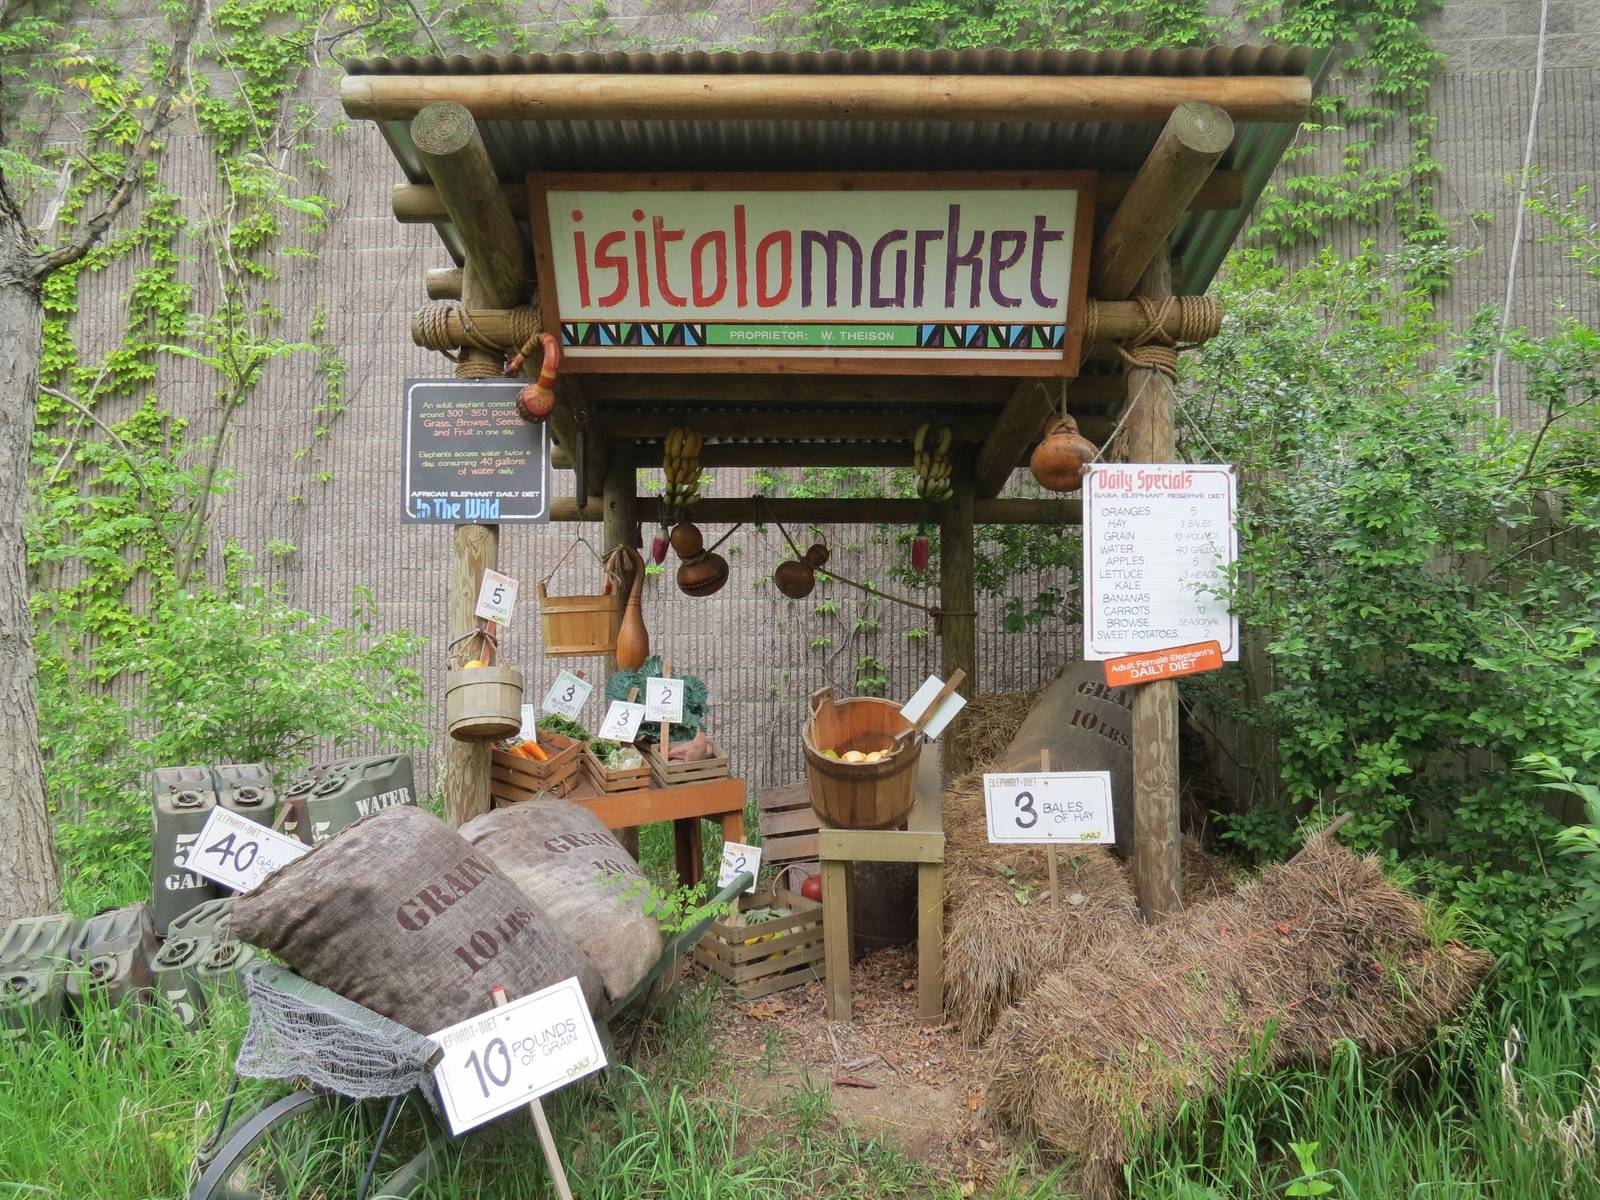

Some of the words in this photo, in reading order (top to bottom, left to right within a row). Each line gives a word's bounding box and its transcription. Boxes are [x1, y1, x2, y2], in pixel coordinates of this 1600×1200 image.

[729, 330, 808, 341] PROPRIETOR:
[821, 330, 836, 341] W.
[841, 331, 895, 341] THEISON
[422, 401, 433, 409] An
[436, 401, 453, 409] adult
[455, 401, 485, 410] elephant
[447, 409, 464, 418] 300
[471, 408, 488, 417] 350
[423, 418, 452, 429] Grass,
[456, 417, 492, 427] Browse,
[495, 416, 526, 427] Seeds,
[432, 428, 450, 437] and
[453, 427, 474, 436] Fruit
[418, 451, 452, 459] Elephants
[504, 449, 524, 457] twice
[438, 459, 477, 468] consuming
[480, 457, 493, 466] 40
[495, 457, 526, 468] gallons
[457, 467, 466, 476] of
[471, 467, 496, 476] water
[1099, 469, 1133, 492] Daily
[1137, 469, 1194, 492] Specials
[1121, 492, 1164, 500] ELEPHANT
[1167, 492, 1205, 500] RESERVE
[1207, 492, 1226, 500] DIET
[432, 498, 461, 520] The
[463, 497, 500, 520] Wild
[1101, 506, 1152, 518] ORANGES
[1190, 506, 1198, 517] 5
[1107, 519, 1128, 529] HAY
[1187, 519, 1212, 529] BALES
[1103, 531, 1136, 542] GRAIN
[1173, 532, 1184, 542] 10
[1100, 544, 1135, 554] WATER
[1175, 545, 1188, 555] 40
[1105, 556, 1145, 567] APPLES
[1192, 556, 1199, 567] 5
[1099, 569, 1144, 579] LETTUCE
[1190, 570, 1218, 579] HEADS
[1114, 580, 1141, 591] KALE
[1177, 583, 1184, 592] 3
[492, 587, 506, 605] 5
[1102, 593, 1151, 604] BANANAS
[1103, 605, 1151, 616] CARROTS
[1196, 605, 1206, 615] 10
[1106, 617, 1151, 629] BROWSE
[1096, 629, 1130, 640] SWEET
[1131, 629, 1179, 639] POTATOES
[1203, 628, 1210, 638] 2
[1111, 664, 1135, 673] Adult
[1136, 656, 1169, 669] Female
[1169, 647, 1215, 664] Elephant's
[1130, 663, 1165, 679] DAILY
[1169, 658, 1198, 672] DIET
[562, 686, 576, 702] 3
[660, 688, 673, 705] 2
[1077, 680, 1134, 711] GRA
[616, 711, 630, 727] 3
[1069, 708, 1098, 730] 10
[354, 786, 412, 817] WATER
[1014, 790, 1039, 829] 3
[1042, 801, 1084, 814] BALES
[1054, 814, 1069, 824] OF
[1074, 811, 1095, 822] HAY
[1079, 831, 1102, 842] DAILY
[173, 832, 201, 868] 5
[205, 831, 259, 873] 40
[733, 856, 747, 874] 2
[164, 872, 209, 891] GAL
[395, 853, 494, 932] GRAIN
[453, 929, 500, 977] 10
[520, 1051, 537, 1067] OF
[541, 1030, 579, 1057] GRAIN
[464, 1036, 512, 1099] 10
[511, 1017, 577, 1058] POUNDS
[565, 1055, 591, 1078] DAILY
